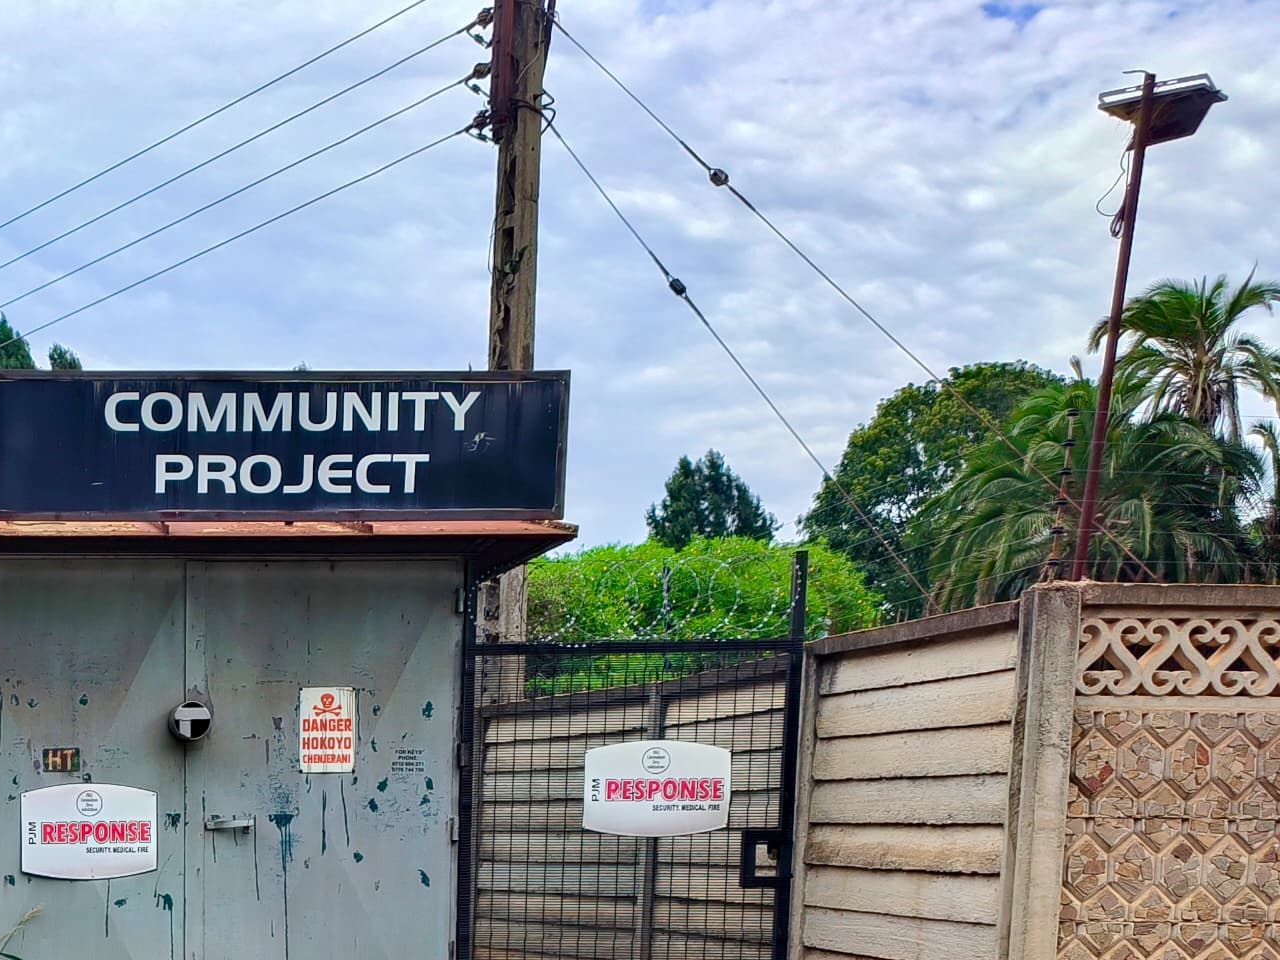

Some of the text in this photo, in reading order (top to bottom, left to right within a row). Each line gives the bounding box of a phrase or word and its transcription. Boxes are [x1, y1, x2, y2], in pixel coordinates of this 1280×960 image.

[104, 391, 481, 432] COMMUNITY
[154, 454, 430, 494] PROJECT
[302, 719, 352, 732] DANGER
[302, 737, 352, 750] HOKOYO
[48, 749, 75, 771] HT
[303, 754, 351, 764] CHENJERANI
[591, 778, 601, 802] PJM
[605, 778, 725, 801] RESPONSE
[708, 804, 721, 812] FIRE
[28, 821, 37, 845] PJM
[41, 820, 151, 845] RESPONSE
[137, 846, 149, 854] FIRE
